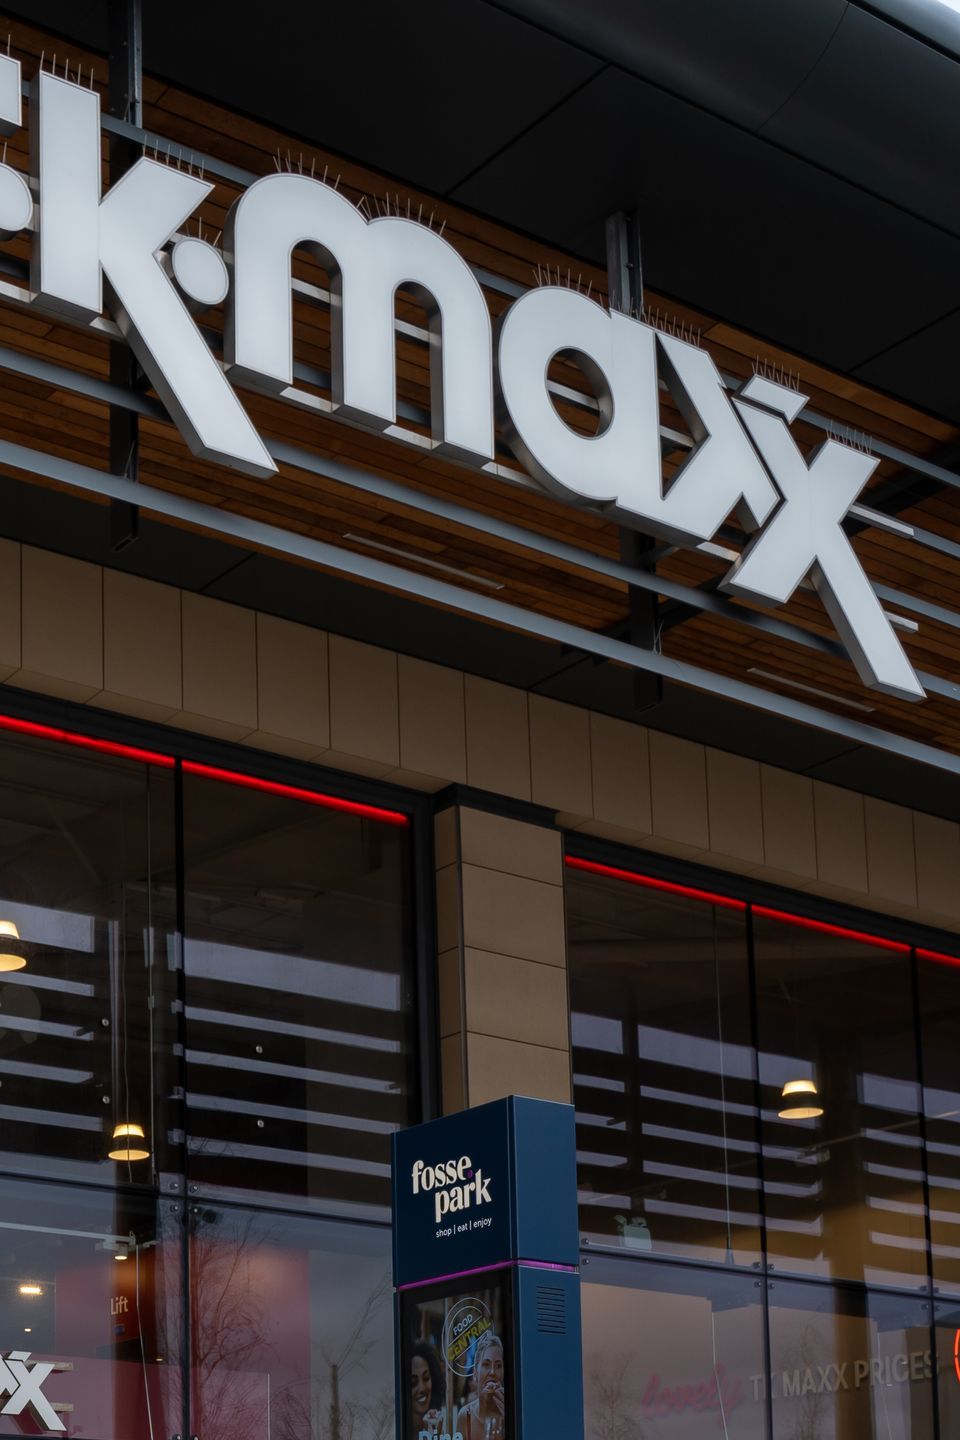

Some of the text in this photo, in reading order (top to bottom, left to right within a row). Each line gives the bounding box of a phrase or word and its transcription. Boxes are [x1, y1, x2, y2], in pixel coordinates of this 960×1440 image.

[411, 1155, 472, 1195] fosse
[435, 1168, 492, 1223] park
[435, 1217, 492, 1238] shop eat enjoy
[110, 1296, 128, 1315] Lift
[447, 1316, 491, 1361] CENTRAL
[453, 1314, 473, 1335] FOOD
[782, 1362, 849, 1397] MAXX
